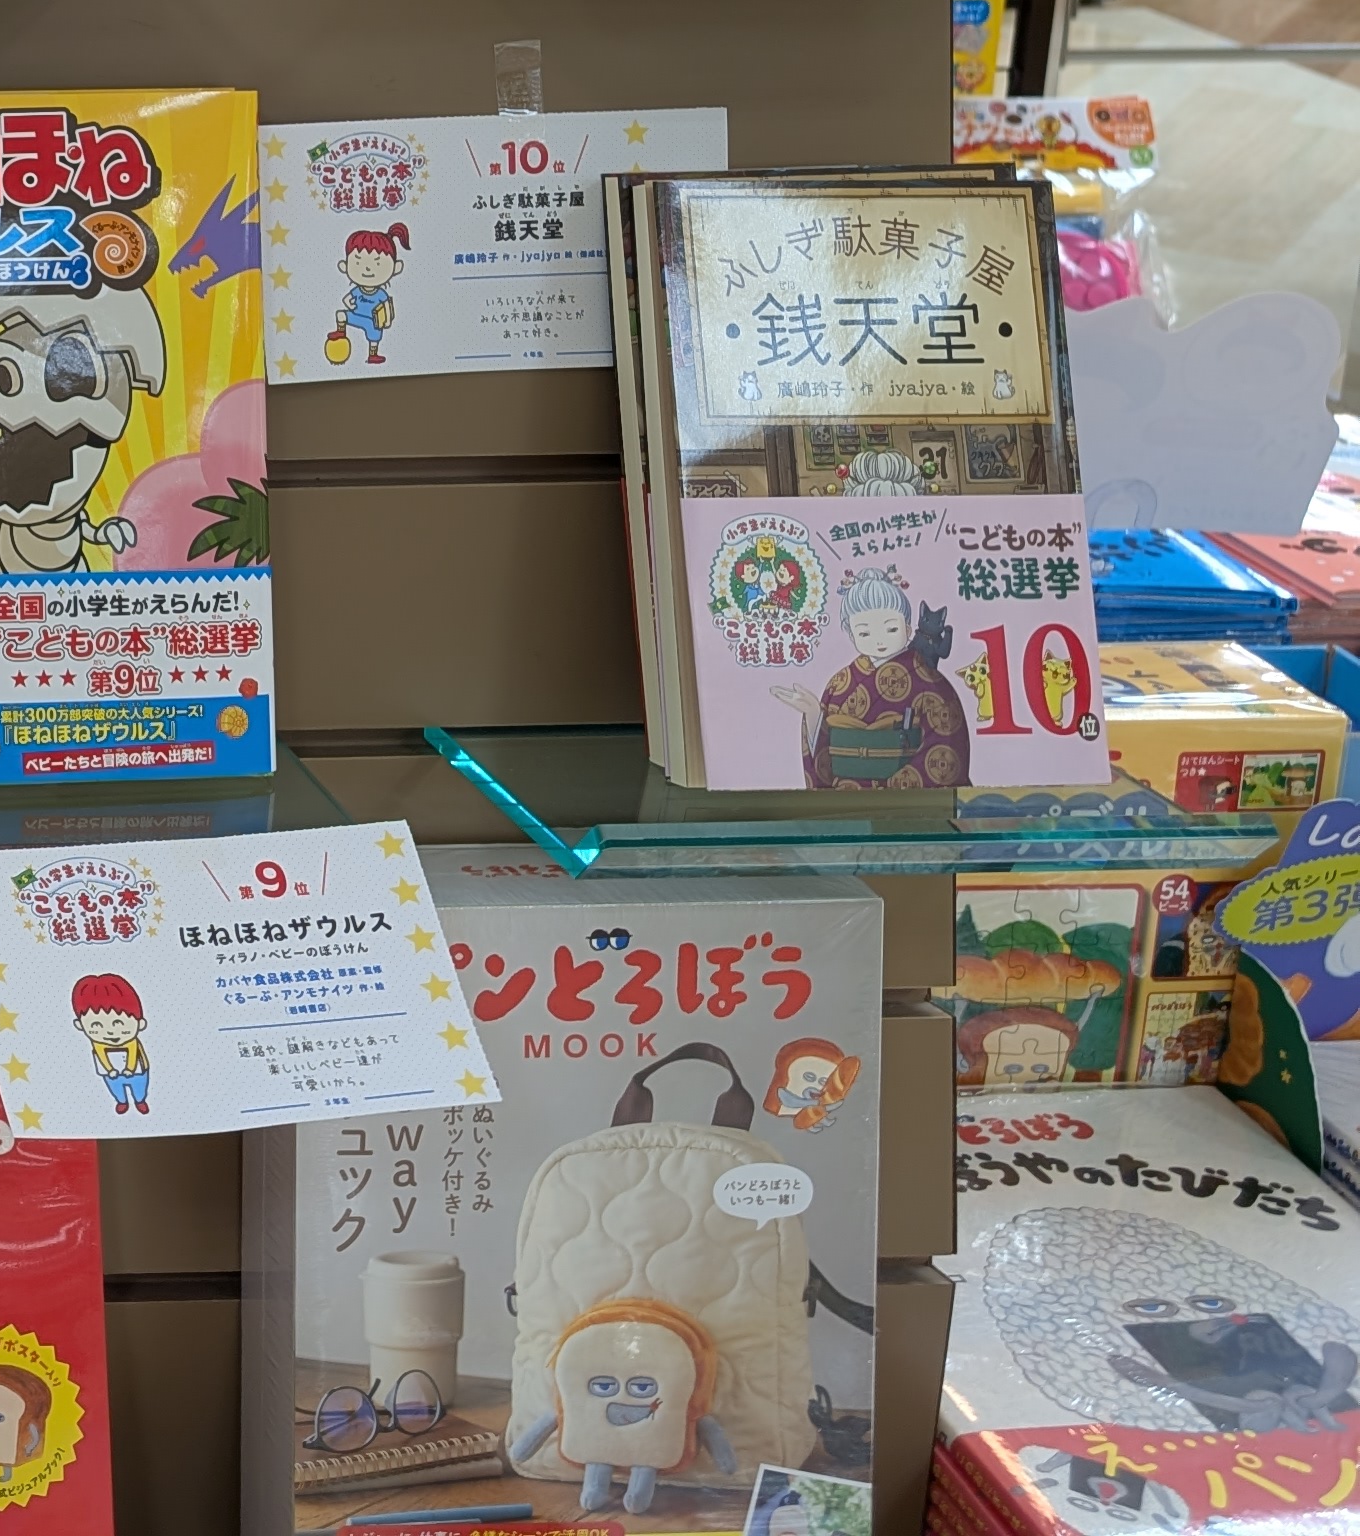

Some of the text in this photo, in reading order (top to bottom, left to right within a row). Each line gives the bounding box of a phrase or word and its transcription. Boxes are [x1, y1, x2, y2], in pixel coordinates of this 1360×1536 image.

[489, 140, 567, 176] 第10位
[472, 191, 585, 209] ふしぎ駄菓子屋
[493, 218, 565, 241] 銭天堂
[721, 214, 1015, 297] ふしぎ駄菓子屋
[751, 292, 985, 366] 銭天堂
[830, 510, 938, 542] 全国の小学生が
[851, 533, 922, 557] えらんだ!
[958, 558, 1081, 601] 総選挙
[87, 665, 161, 696] 第9位
[239, 861, 311, 900] 第9位
[1158, 879, 1190, 901] 54
[179, 911, 393, 948] ほねほねザウルス
[215, 942, 369, 964] ティラノ・ベビーのぼうけん
[523, 1033, 660, 1058] MOOK
[472, 1104, 495, 1212] ぬいぐるみ
[724, 1177, 802, 1193] パンどろぼうと
[729, 1192, 796, 1207] いつも一緒!
